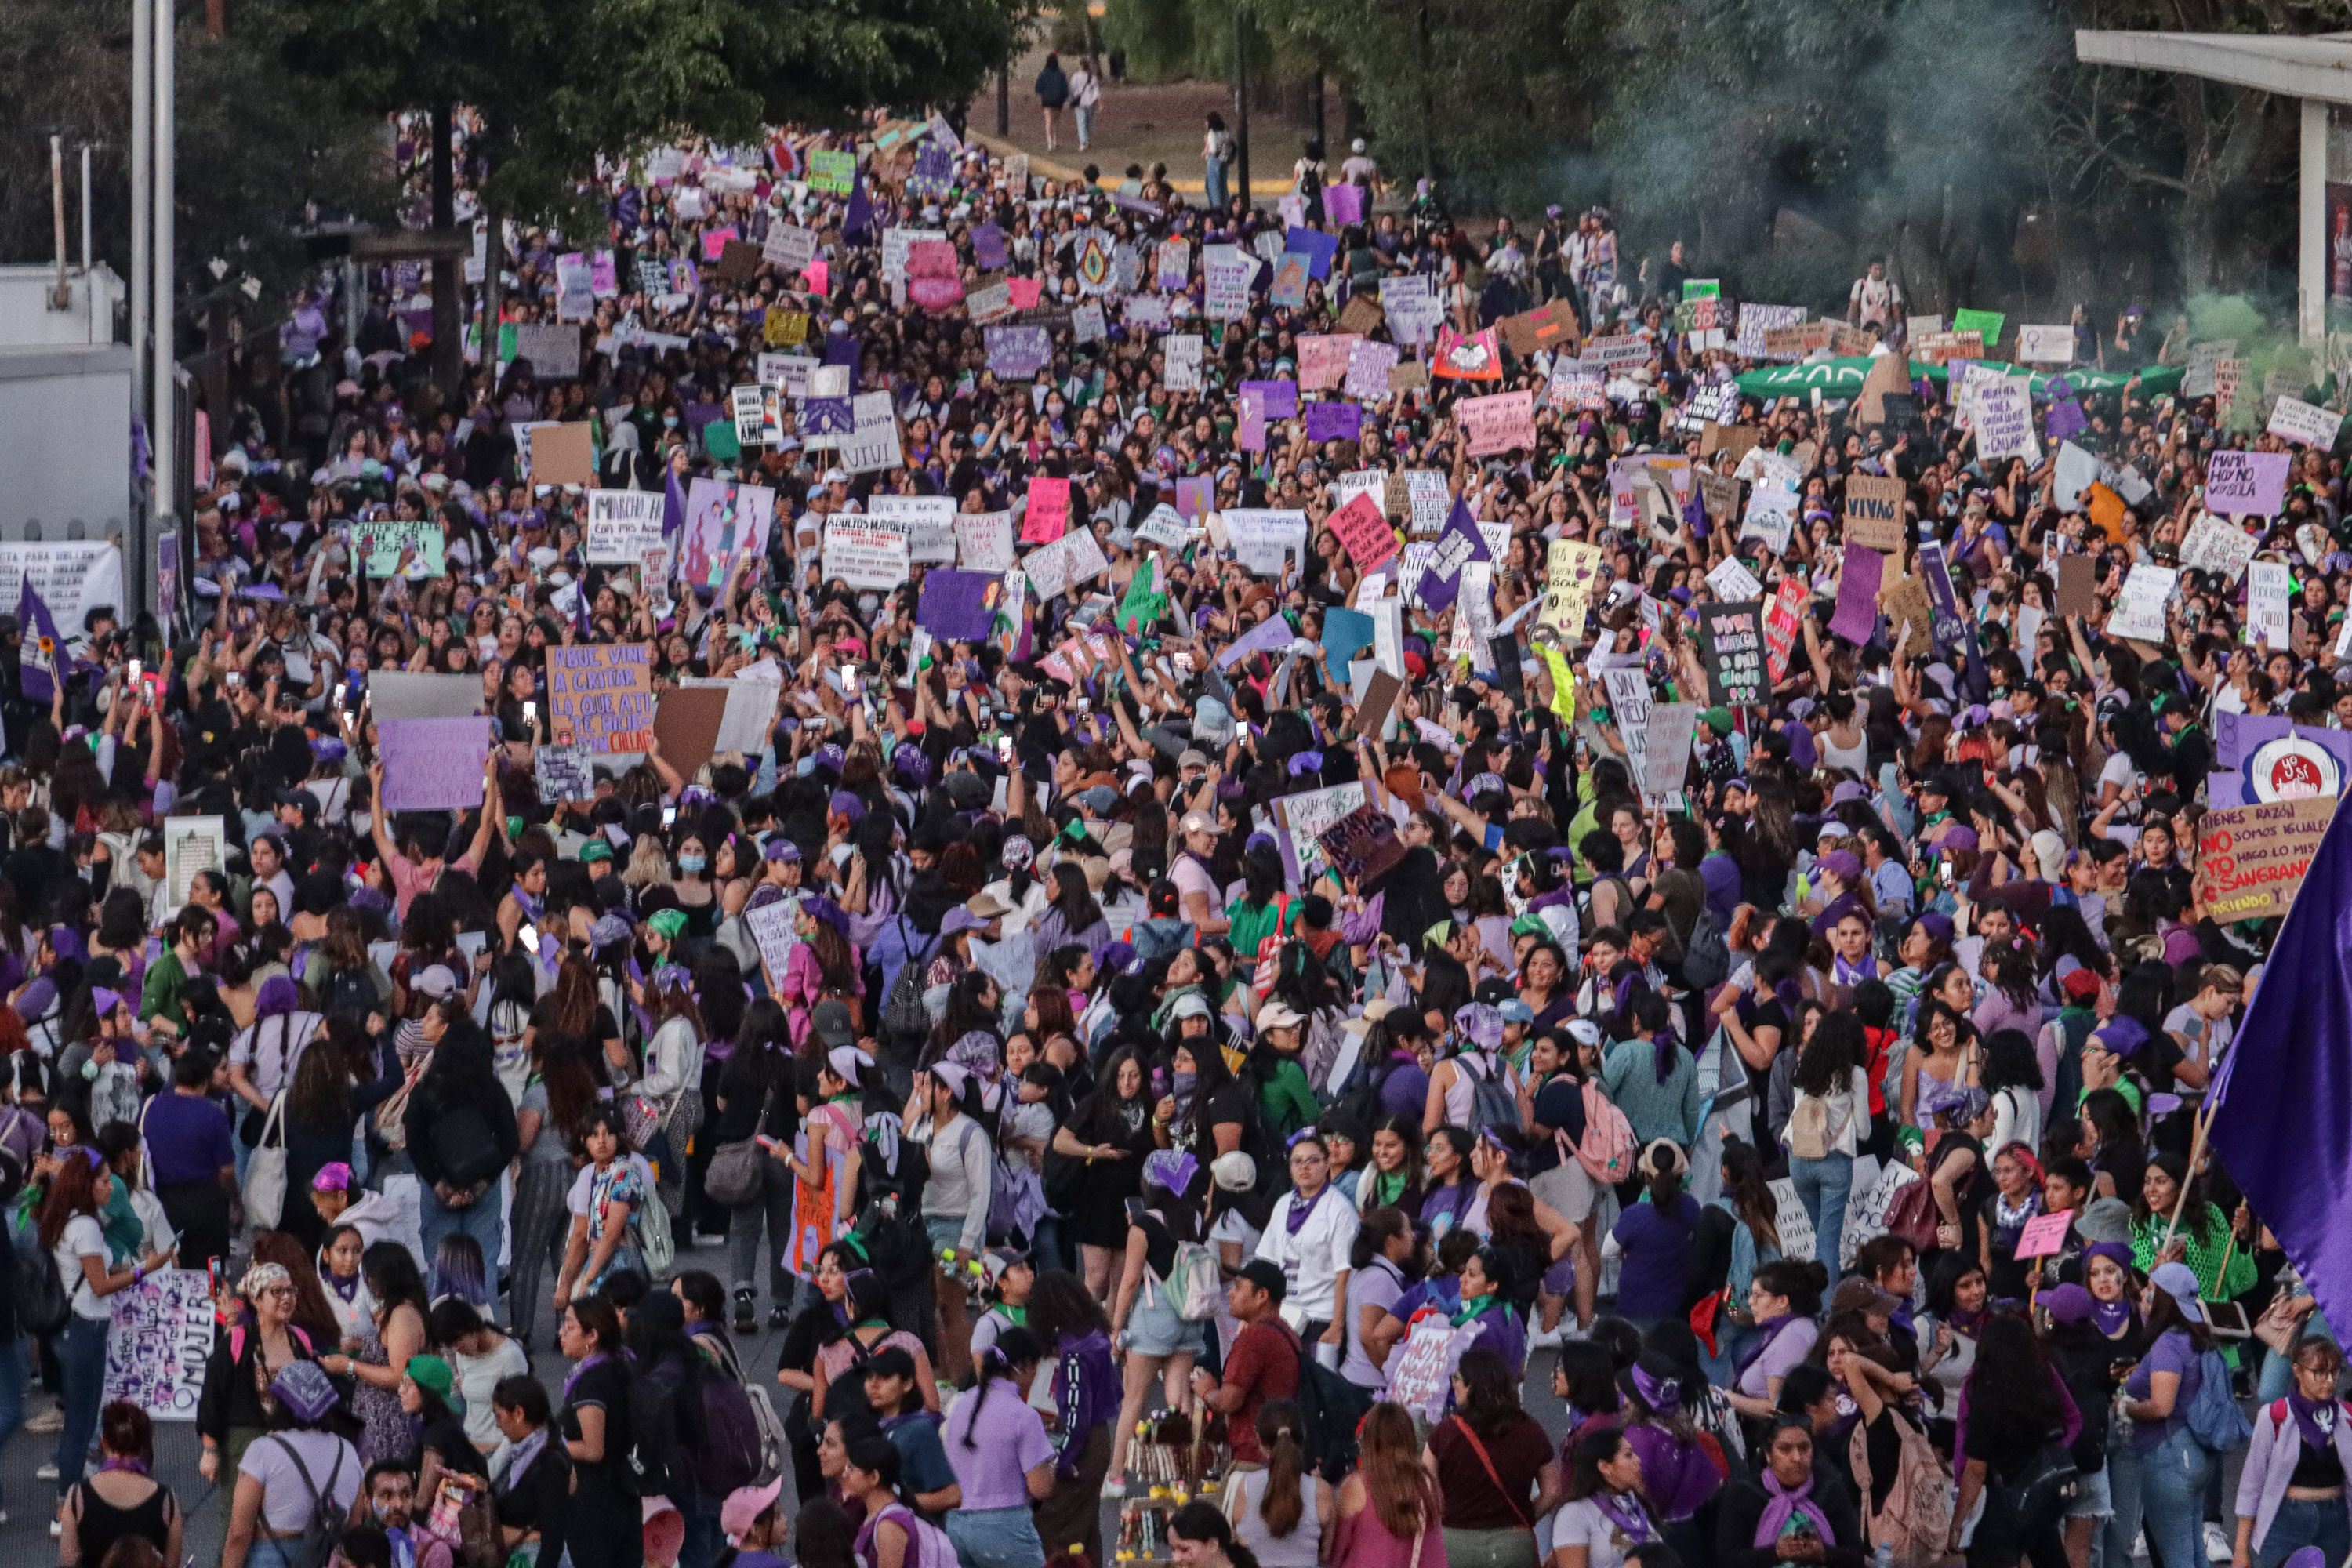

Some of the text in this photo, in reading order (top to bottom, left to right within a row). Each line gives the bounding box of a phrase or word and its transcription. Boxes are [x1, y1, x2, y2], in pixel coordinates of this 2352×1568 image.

[1682, 312, 1732, 329] TODAS
[2210, 467, 2254, 483] HOY NO
[2209, 481, 2256, 497] VOY SOLA
[1340, 504, 1355, 521] MI
[1848, 498, 1896, 521] VIVAS
[827, 517, 868, 530] ADULTOS
[869, 518, 912, 534] MAYORES
[1427, 527, 1465, 573] NI UNA
[1435, 537, 1475, 584] MENOS
[2252, 568, 2281, 584] LIBRES
[2261, 611, 2284, 627] MIEDO
[555, 645, 650, 669] ABUE VINE
[556, 669, 637, 694] A GRITAR
[1613, 670, 1636, 698] SIN
[553, 696, 574, 717] LO
[581, 693, 614, 715] QUE
[575, 715, 596, 733] TE
[2281, 755, 2298, 779] yo
[2296, 764, 2309, 780] sí
[2276, 781, 2289, 795] te
[2201, 811, 2246, 829] TIENES
[2201, 818, 2329, 856] NO SOMOS IGUALE
[2204, 855, 2235, 878] YO
[2237, 848, 2268, 863] HAGO
[2272, 844, 2289, 857] LO
[2272, 887, 2283, 904] Y
[138, 1297, 158, 1345] MIEDO
[182, 1294, 212, 1387] MUJER
